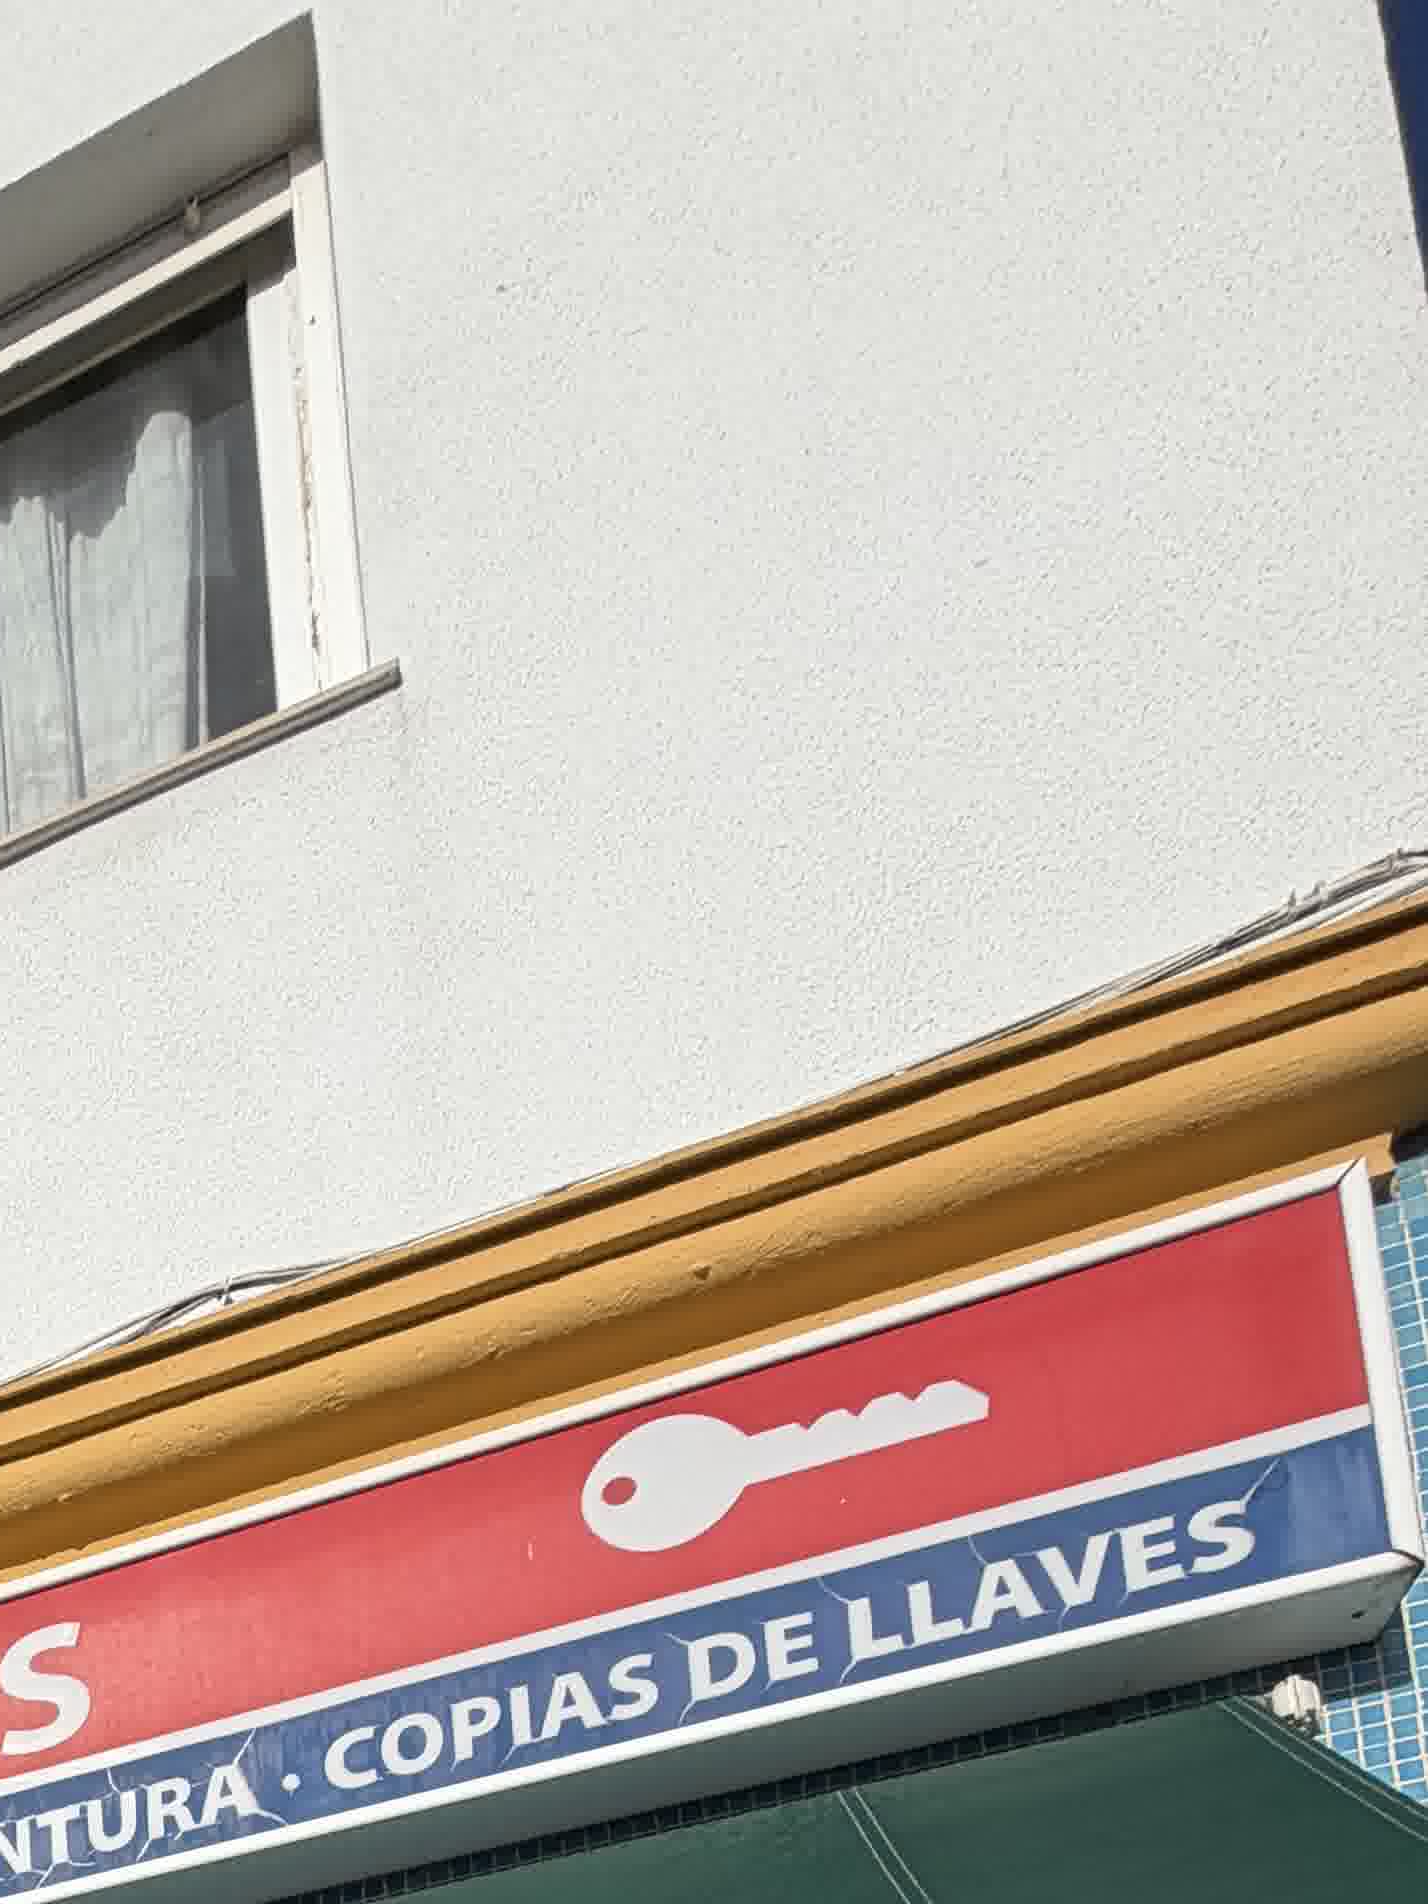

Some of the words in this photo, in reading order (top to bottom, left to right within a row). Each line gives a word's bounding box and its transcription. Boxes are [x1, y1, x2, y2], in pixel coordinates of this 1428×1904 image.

[324, 1653, 658, 1790] COPIAS
[689, 1613, 818, 1702] DE
[851, 1499, 1256, 1664] LLAVES
